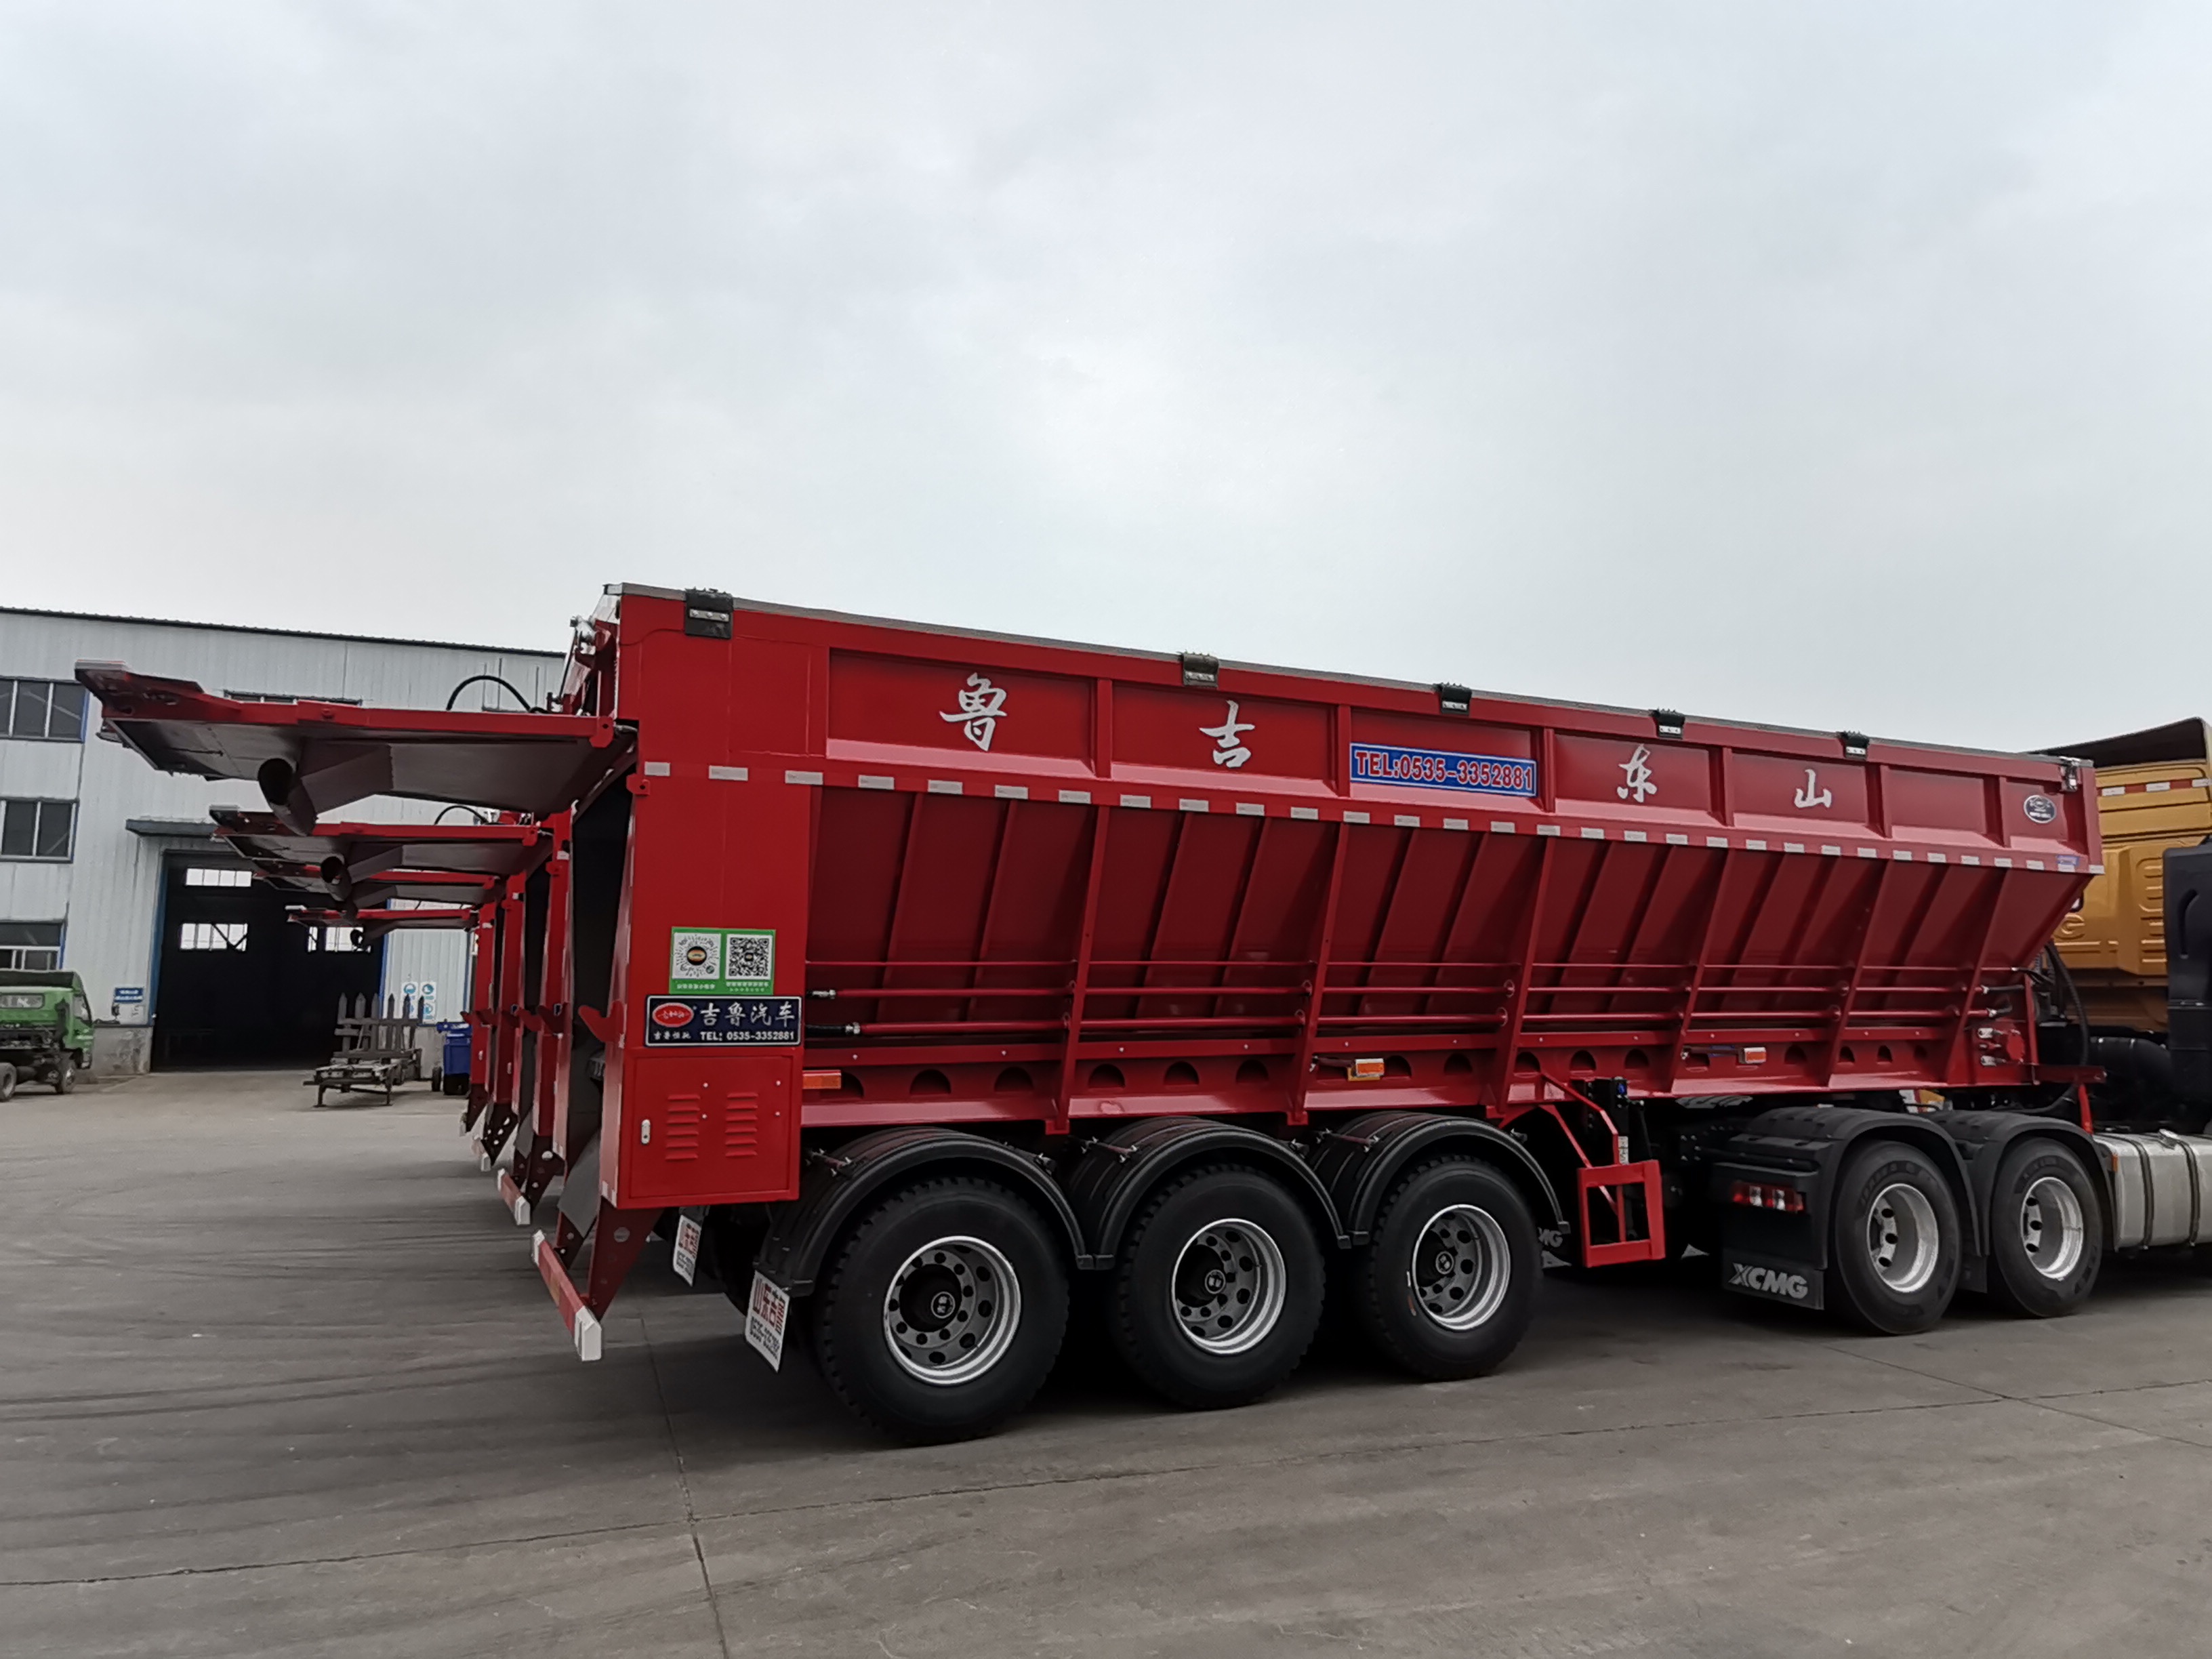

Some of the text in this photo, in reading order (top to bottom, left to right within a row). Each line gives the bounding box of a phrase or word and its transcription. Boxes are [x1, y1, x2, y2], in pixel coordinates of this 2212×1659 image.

[939, 672, 1008, 752] 鲁
[1198, 699, 1256, 769] 吉
[1355, 750, 1533, 792] TEL:0535-3352881
[1616, 743, 1658, 803] 东
[1794, 769, 1832, 808] 山
[700, 1001, 796, 1028] 吉鲁汽车
[700, 1031, 794, 1041] TEL: 0535-3352881
[1728, 1262, 1808, 1299] XCMG
[752, 1277, 785, 1336] 山东吉鲁
